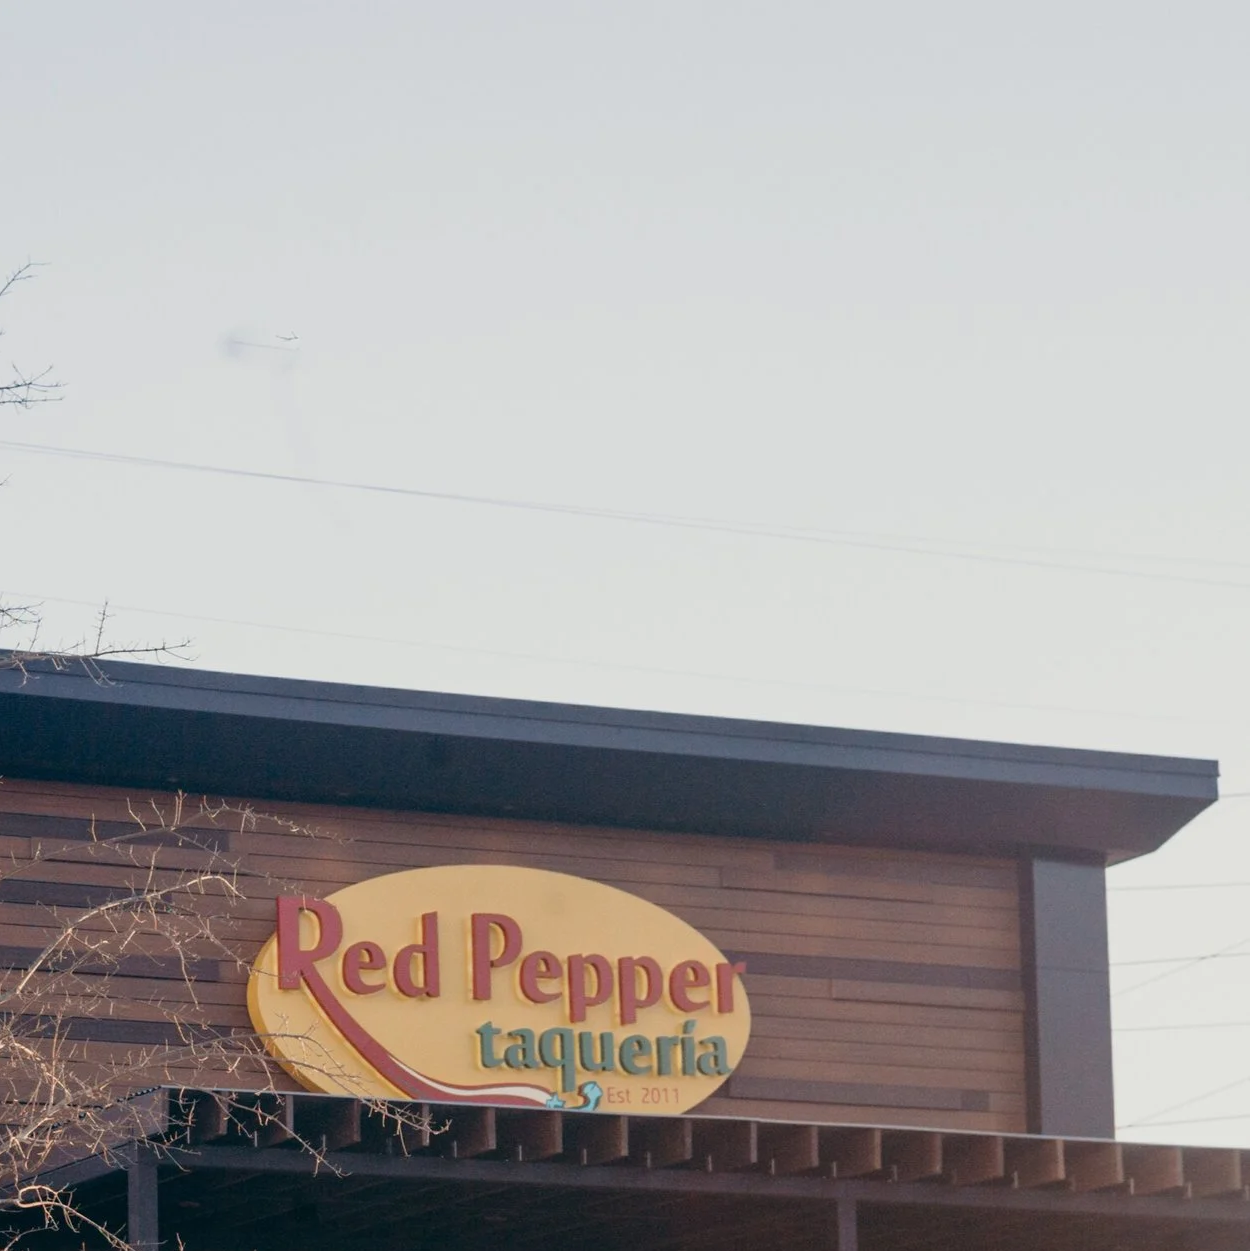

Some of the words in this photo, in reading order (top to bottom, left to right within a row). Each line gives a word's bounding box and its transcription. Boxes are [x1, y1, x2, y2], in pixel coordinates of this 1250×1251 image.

[275, 896, 441, 999] Red
[470, 912, 747, 1026] Pepper
[475, 1018, 732, 1093] taquería
[606, 1086, 632, 1105] Est
[641, 1086, 680, 1105] 2011
